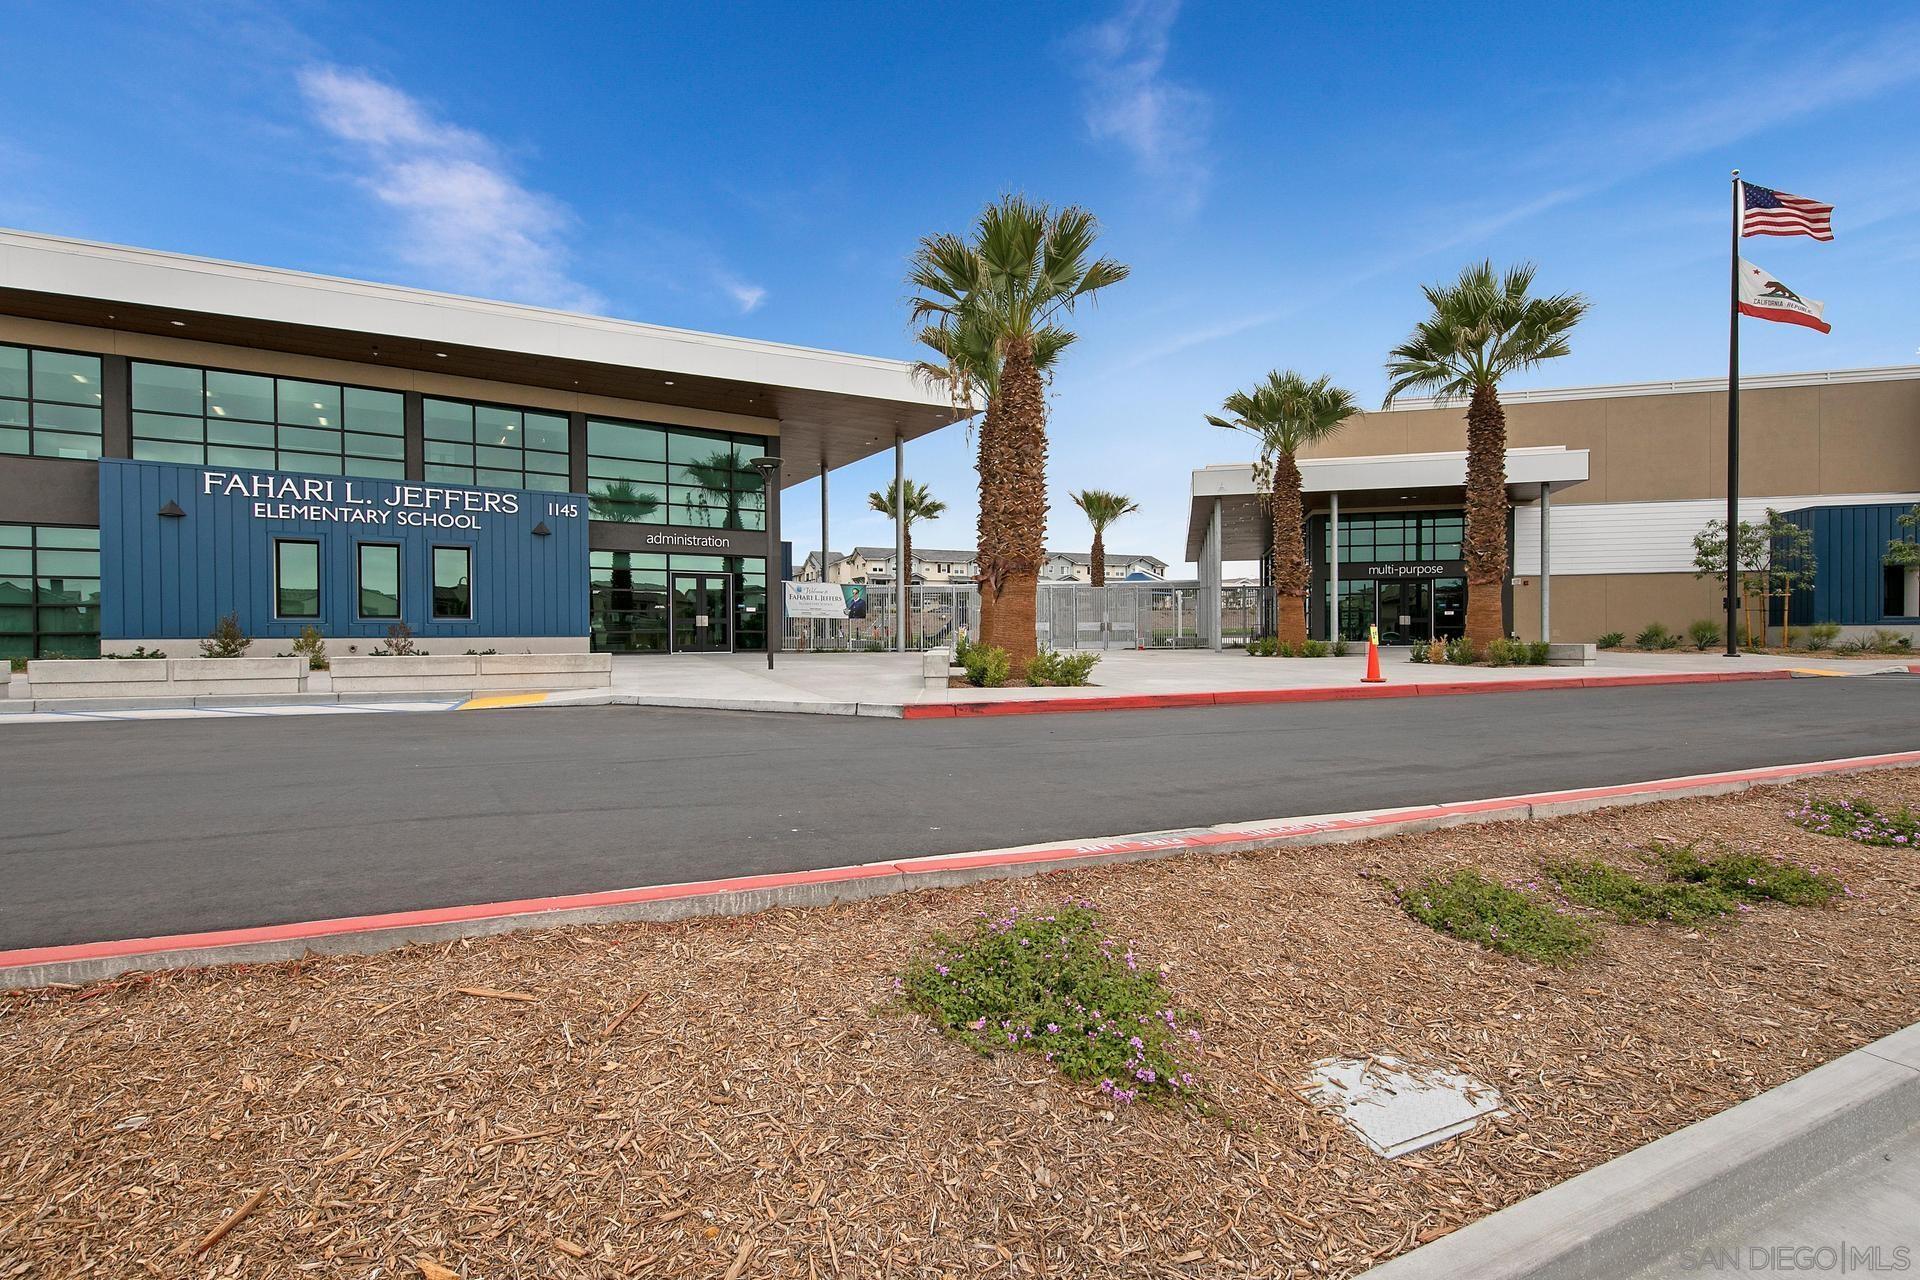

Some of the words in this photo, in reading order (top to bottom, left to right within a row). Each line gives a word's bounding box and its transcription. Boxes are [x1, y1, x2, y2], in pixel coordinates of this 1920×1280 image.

[1753, 298, 1784, 307] CALIFORNIA
[204, 471, 334, 502] FAHARI
[345, 482, 372, 504] L.
[384, 486, 519, 514] JEFFERS
[254, 503, 391, 524] ELEMENTARY
[397, 512, 482, 530] SCHOOL
[548, 502, 578, 518] 1145
[646, 532, 730, 548] administration
[1368, 564, 1444, 577] multi-purpose
[1141, 838, 1186, 847] FIRE
